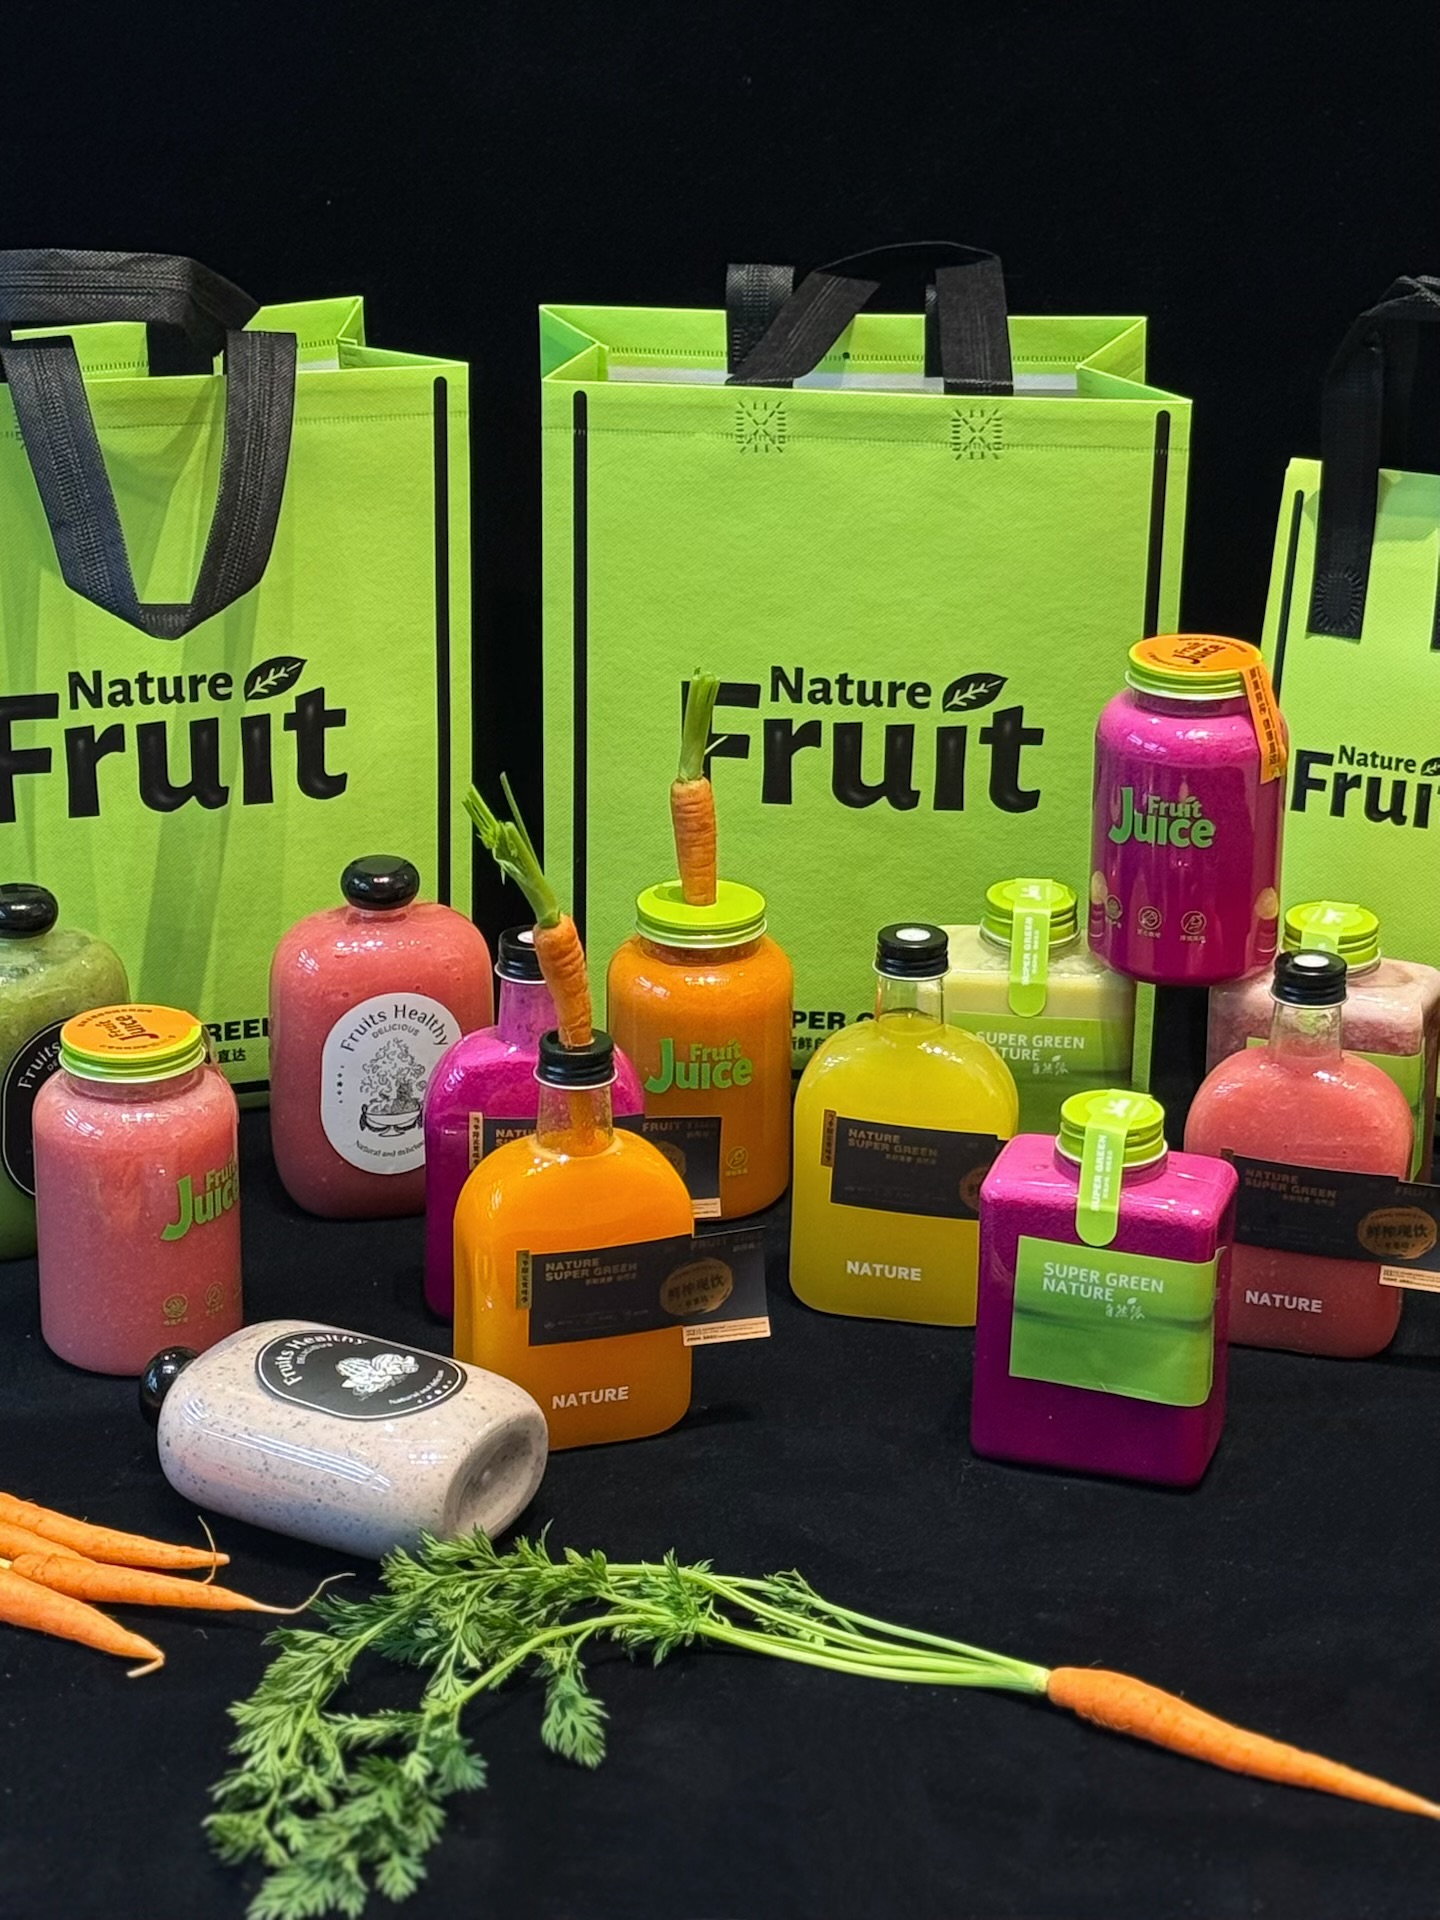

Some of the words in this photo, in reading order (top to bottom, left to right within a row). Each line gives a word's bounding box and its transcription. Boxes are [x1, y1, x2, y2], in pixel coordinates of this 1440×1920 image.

[68, 669, 234, 710] Nature
[770, 665, 932, 710] Nature
[0, 687, 348, 824] Fruit
[681, 680, 1045, 814] Fruit
[1338, 744, 1417, 774] Nature
[1290, 749, 1440, 829] Frui
[1108, 786, 1217, 849] Juice
[1147, 796, 1203, 819] Fruit
[340, 1010, 388, 1052] Fruits
[393, 1004, 449, 1046] Healthy
[371, 1023, 421, 1039] DELICIOUS
[975, 1031, 1028, 1047] SUPER
[1032, 1035, 1085, 1049] GREEN
[690, 1040, 742, 1062] Fruit
[991, 1046, 1041, 1061] TURE
[17, 1041, 61, 1089] Fruits
[644, 1038, 753, 1094] Juice
[847, 1128, 901, 1144] NATURE
[847, 1138, 890, 1153] SUPER
[893, 1144, 938, 1157] GREEN
[545, 1257, 600, 1272] NATURE
[545, 1267, 590, 1282] SUPER
[593, 1262, 638, 1277] GREEN
[847, 1260, 922, 1281] NATURE
[1042, 1277, 1115, 1302] NATURE
[1043, 1261, 1101, 1284] SUPER
[1105, 1272, 1165, 1294] GREEN
[1245, 1290, 1323, 1313] NATURE
[274, 1349, 303, 1387] Fruits
[551, 1386, 630, 1410] NATURE
